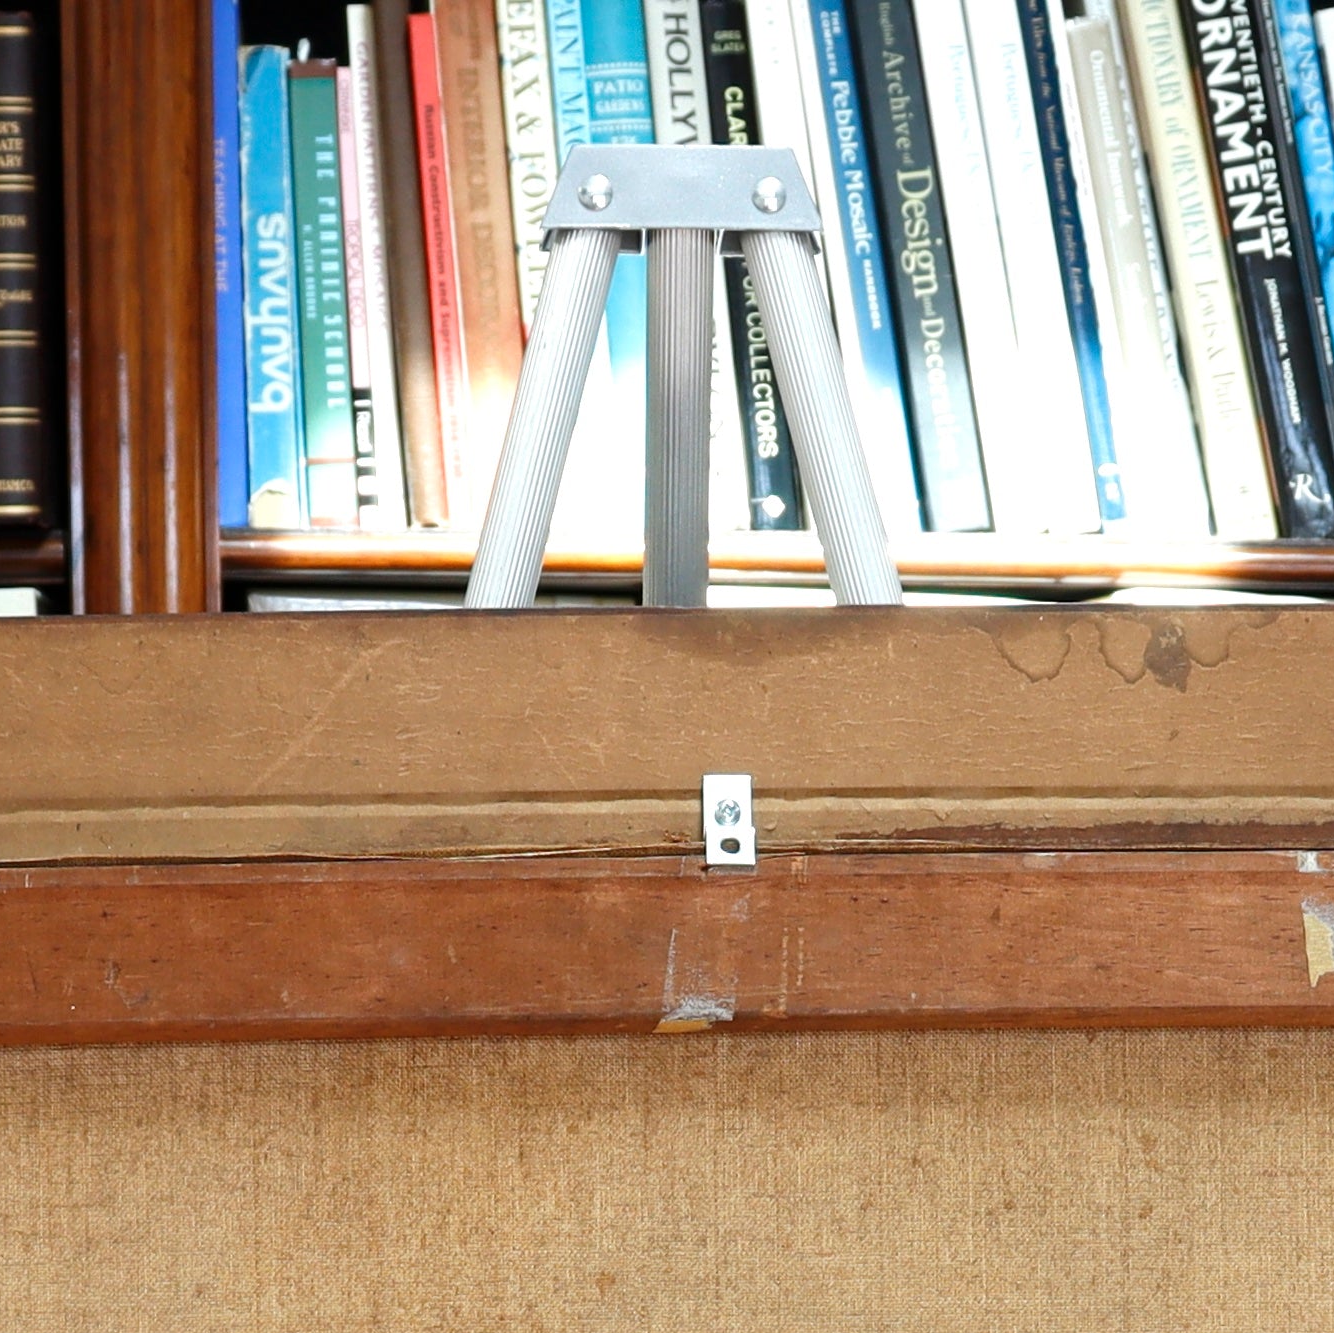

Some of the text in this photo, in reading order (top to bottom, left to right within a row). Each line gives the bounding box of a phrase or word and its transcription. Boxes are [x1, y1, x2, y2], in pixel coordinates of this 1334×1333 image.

[355, 41, 373, 123] GARDEN
[593, 79, 644, 96] PATIO
[831, 9, 842, 35] THE
[1289, 13, 1328, 119] KANSAS
[213, 138, 227, 228] TEACHING
[423, 104, 438, 160] Russian
[458, 68, 492, 212] INTERIOR
[819, 9, 882, 332] COMPLETE Pebble Mosaic HANDBOOK
[881, 49, 944, 299] Archive Design
[1089, 49, 1134, 229] Ornamental Ironwork
[1191, 0, 1274, 261] ORNAMENT
[1257, 139, 1293, 260] CENTURY
[313, 133, 348, 410] THE PRAIRIE SCHOOL
[428, 165, 448, 275] Constructivism
[1164, 115, 1224, 341] of ORNAMENT Lewis
[248, 213, 291, 413] bauhaus
[746, 311, 780, 459] COLLECTORS
[1262, 278, 1302, 425] JONATHAN WOODHAM
